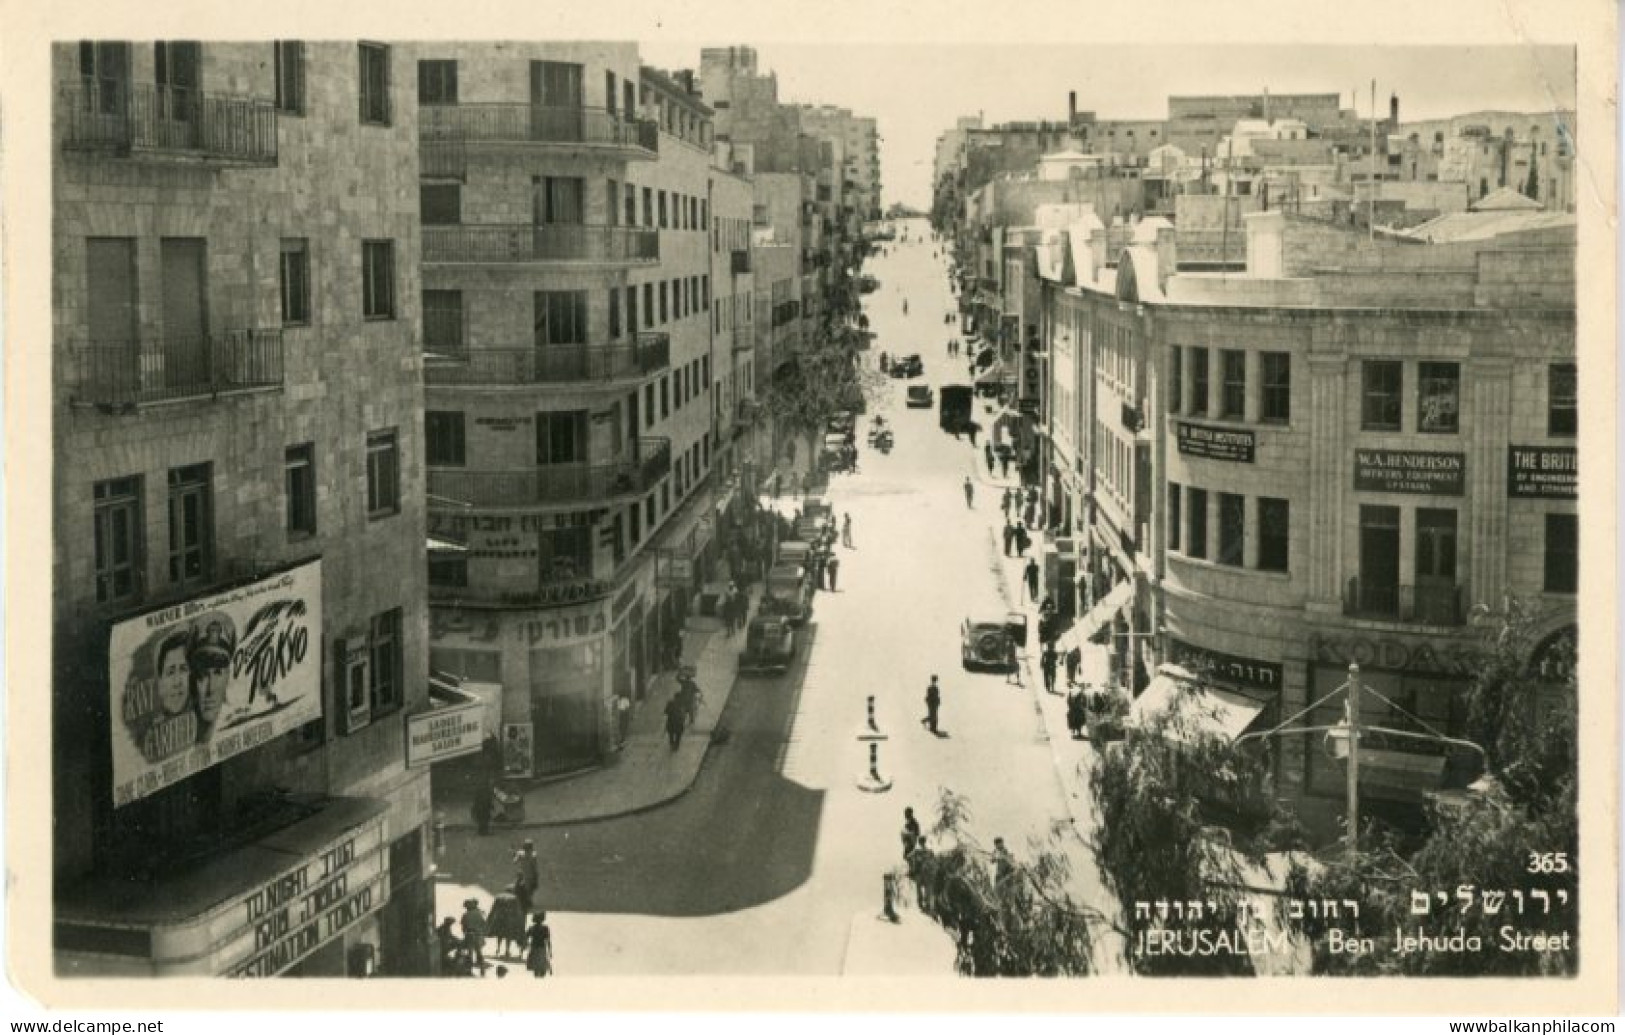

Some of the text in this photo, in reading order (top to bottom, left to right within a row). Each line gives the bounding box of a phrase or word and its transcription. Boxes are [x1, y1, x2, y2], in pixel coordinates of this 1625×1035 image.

[1514, 451, 1537, 469] THE
[245, 619, 308, 704] TOKYO
[244, 864, 308, 923] TONIGHT
[321, 886, 371, 938] TOKYO
